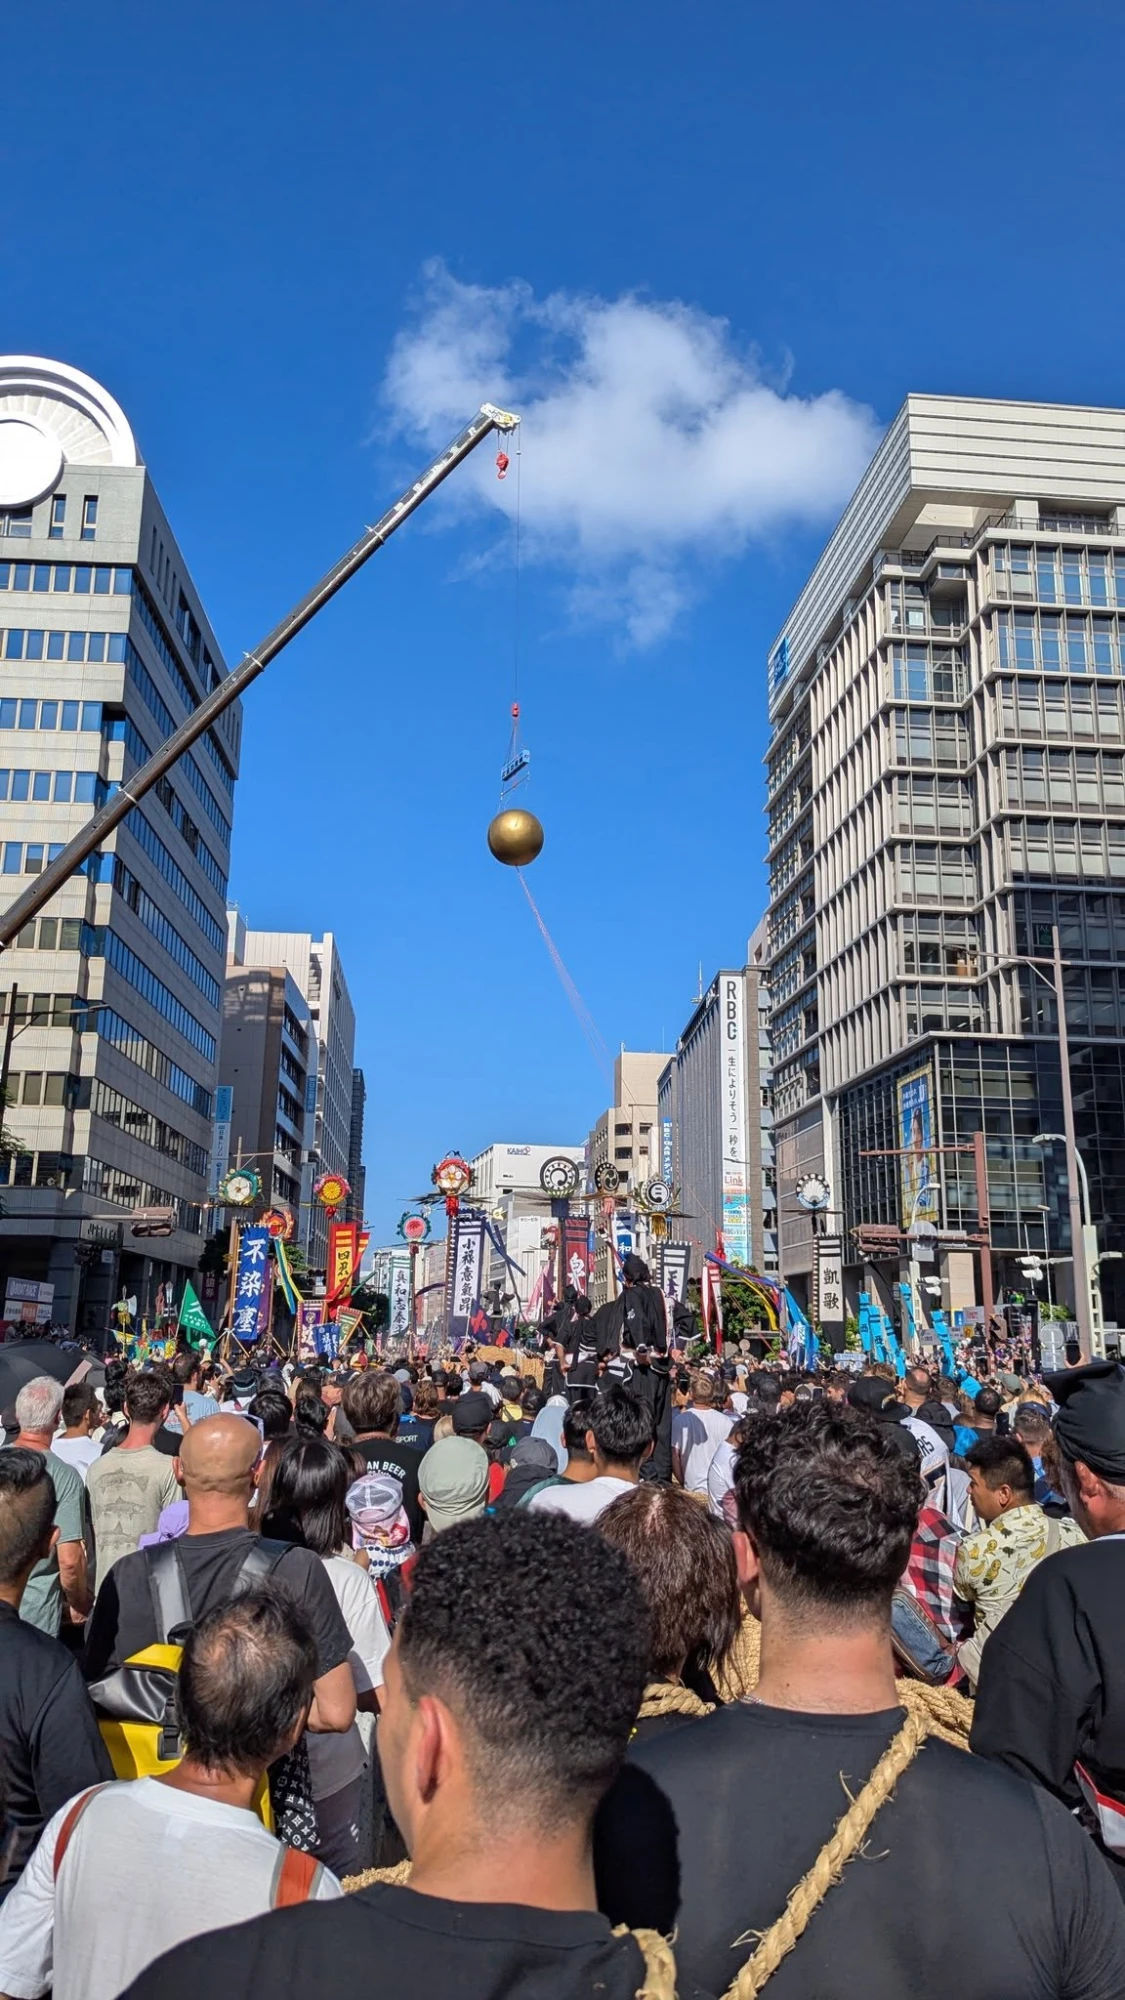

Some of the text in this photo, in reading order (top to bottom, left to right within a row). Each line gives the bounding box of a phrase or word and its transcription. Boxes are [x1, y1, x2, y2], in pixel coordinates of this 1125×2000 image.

[727, 980, 737, 1040] RBC
[724, 1175, 743, 1184] Link
[822, 1267, 840, 1310] 凱歌
[395, 1434, 418, 1444] SPORT
[382, 1461, 406, 1479] BEER
